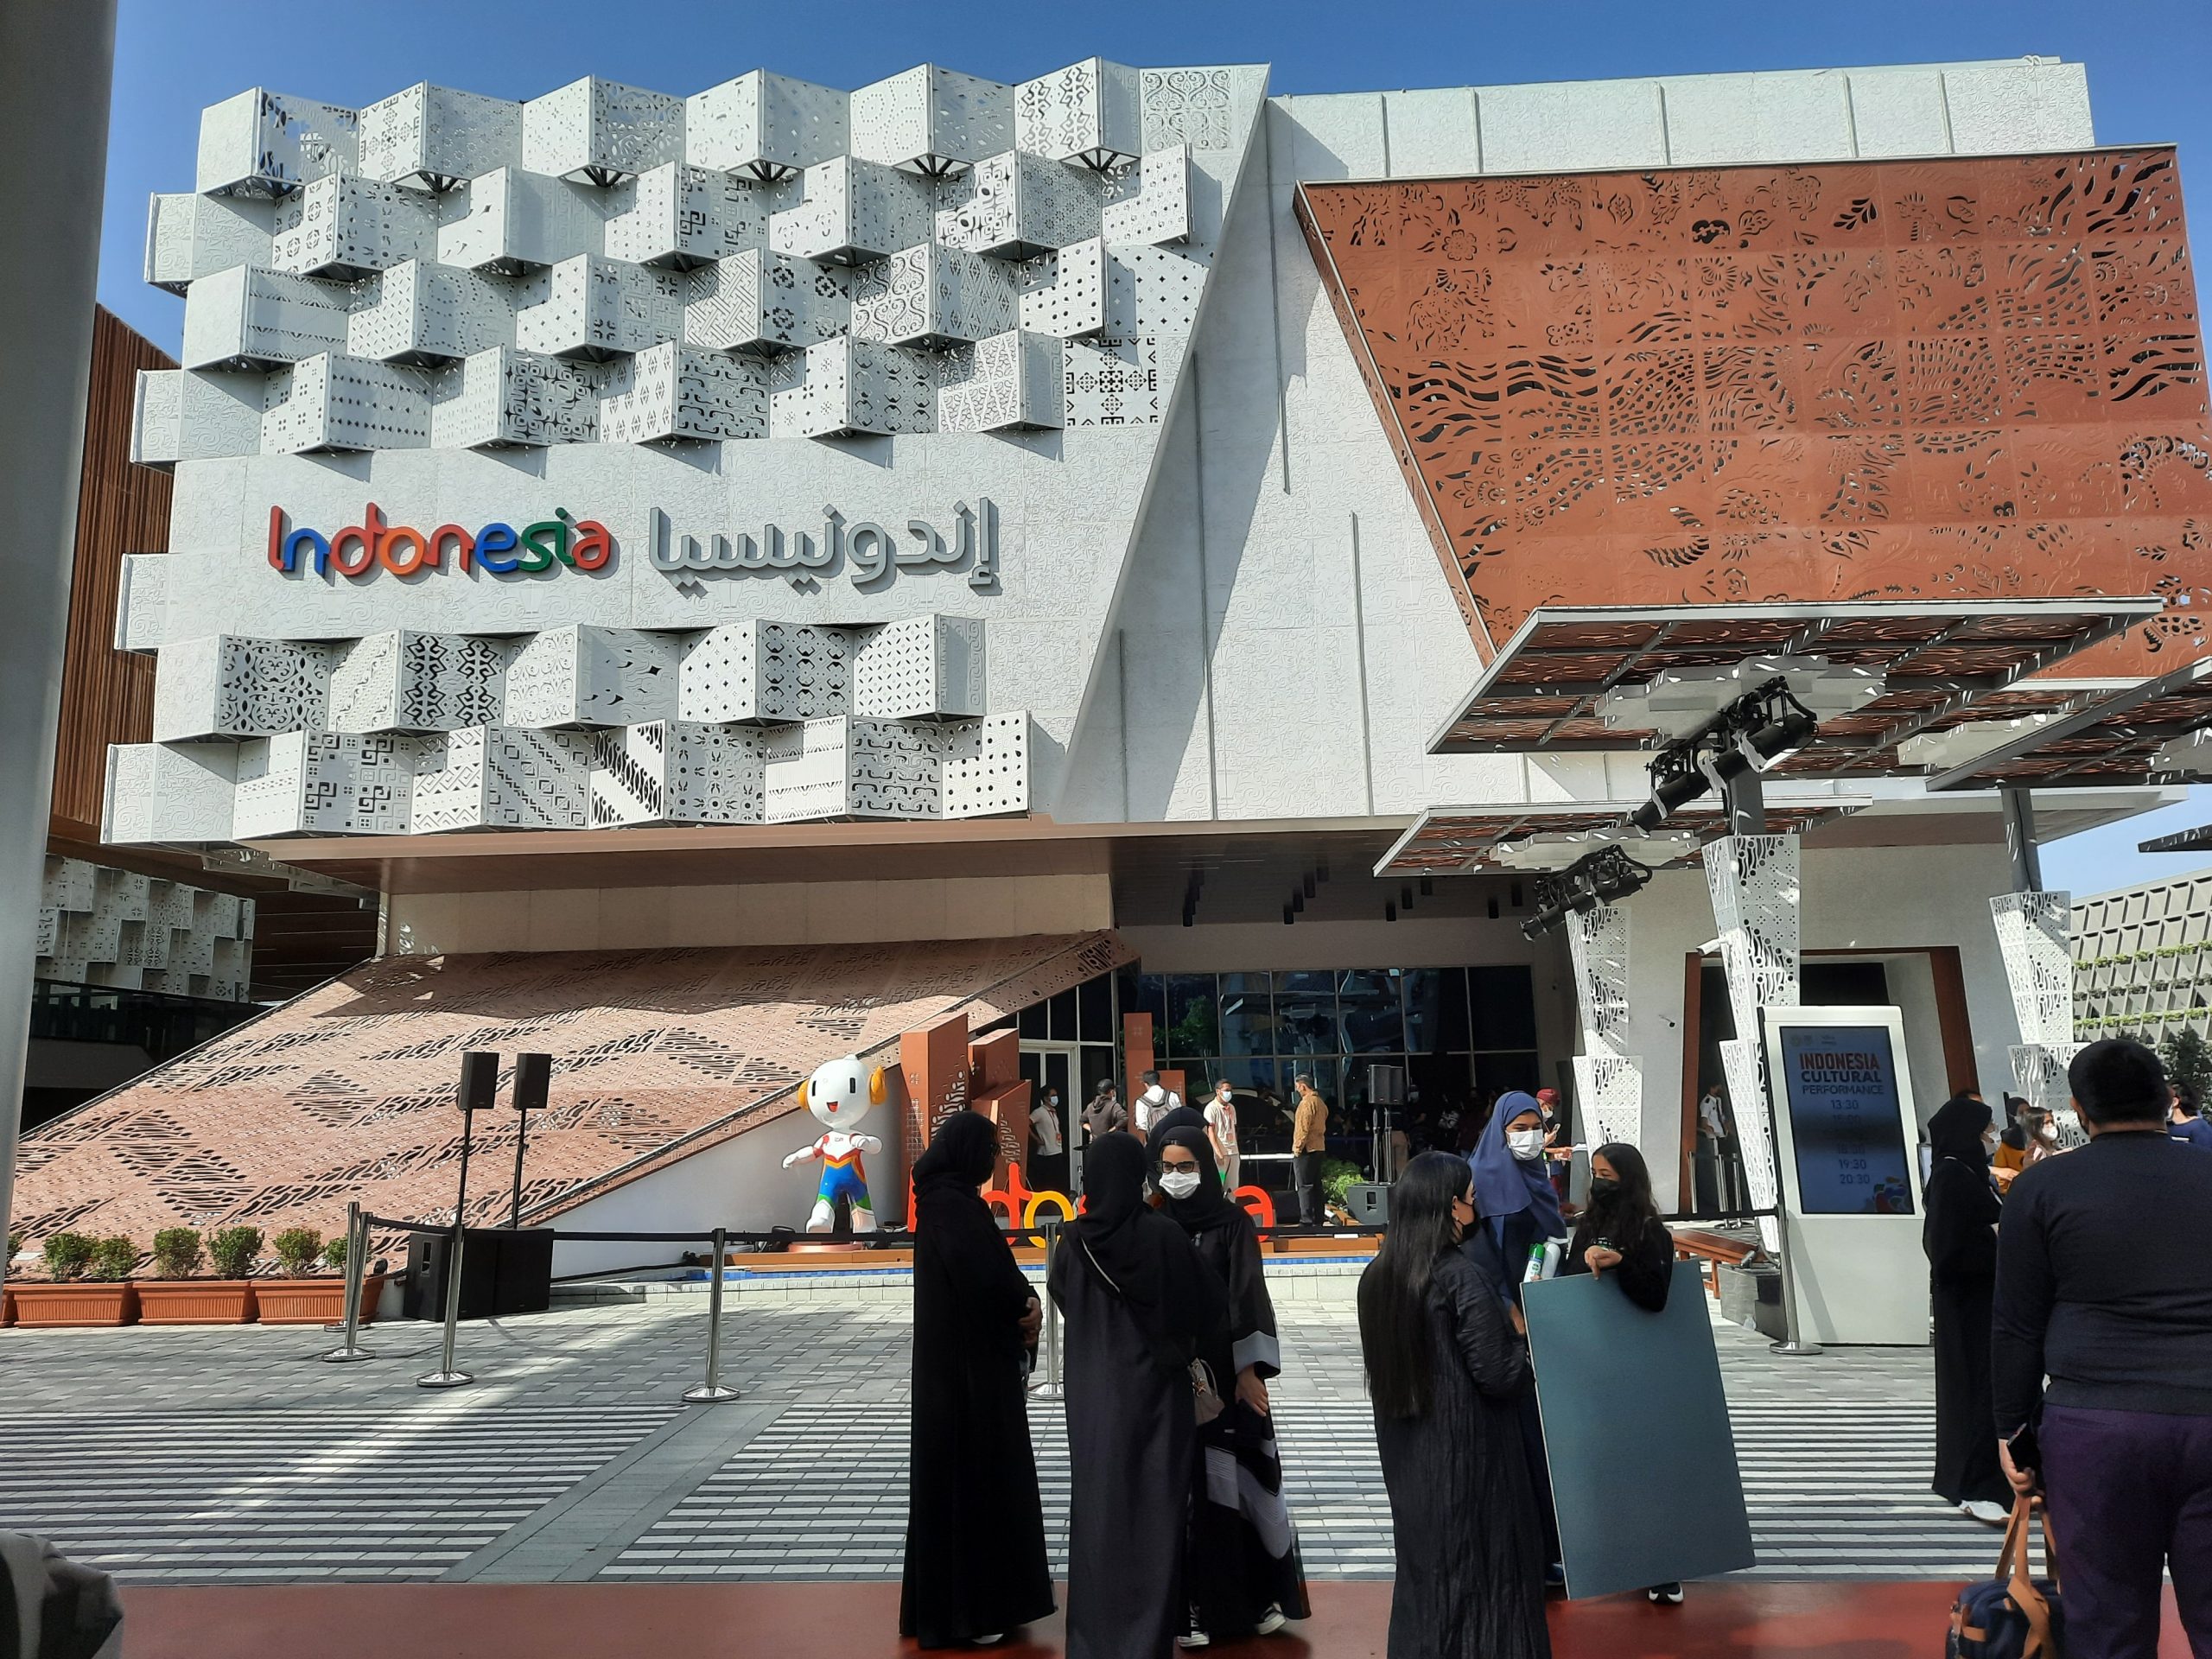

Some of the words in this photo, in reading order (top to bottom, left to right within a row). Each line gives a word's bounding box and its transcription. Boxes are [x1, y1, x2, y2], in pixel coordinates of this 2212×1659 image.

[268, 502, 611, 577] Indonesia
[650, 497, 996, 591] إندونيسيا
[1800, 1052, 1880, 1071] INDONESIA
[1801, 1071, 1882, 1083] CULTURAL
[1802, 1084, 1885, 1095] PERFORMANCE
[1830, 1099, 1859, 1109] 13:30
[1838, 1159, 1866, 1169] 19:30
[1840, 1173, 1870, 1184] 20:30
